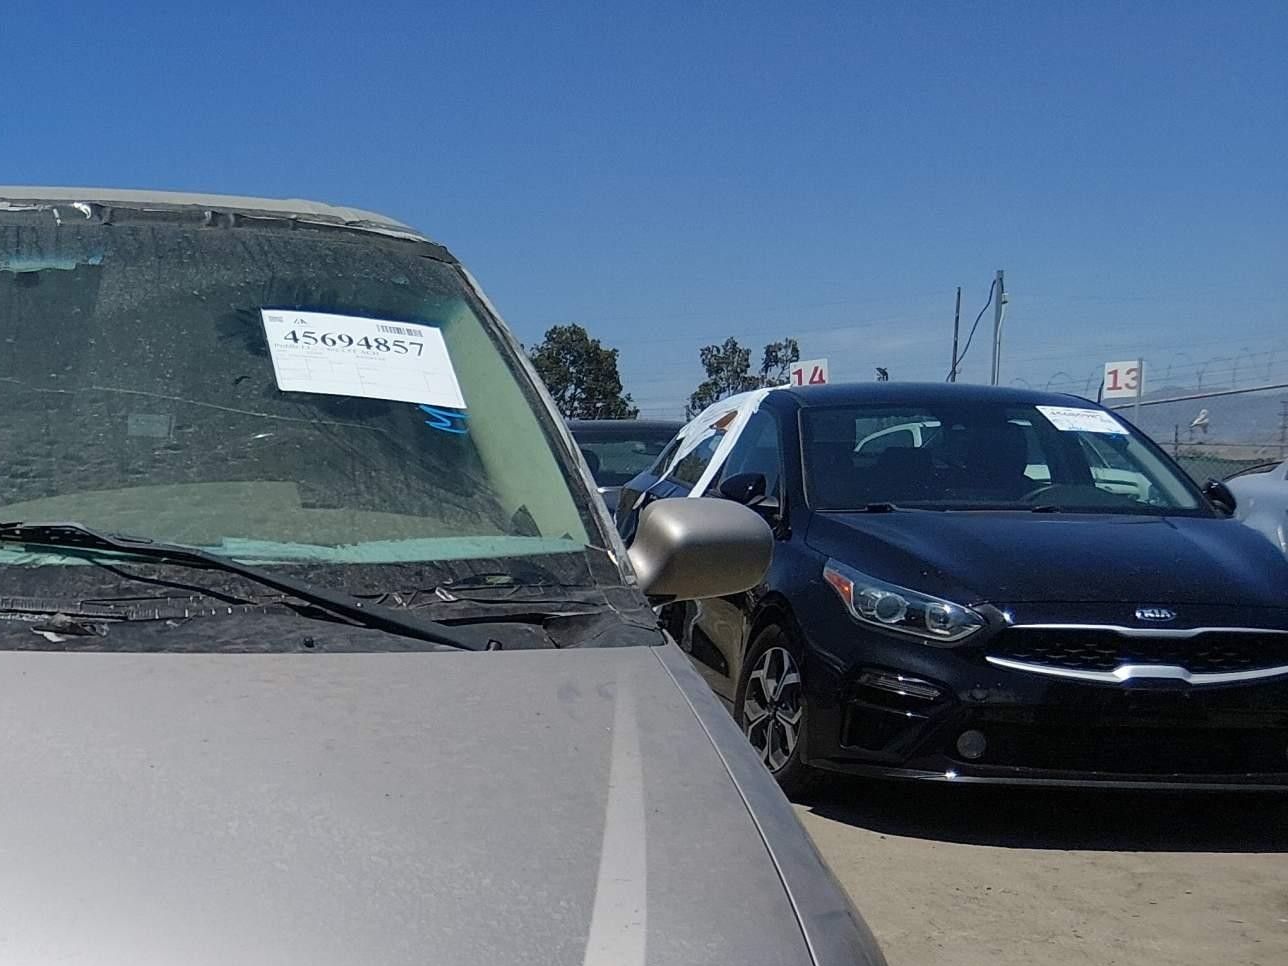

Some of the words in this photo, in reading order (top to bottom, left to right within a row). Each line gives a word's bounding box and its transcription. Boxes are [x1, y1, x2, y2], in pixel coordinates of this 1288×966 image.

[283, 329, 424, 357] 45694857
[792, 365, 826, 386] 14
[1106, 367, 1139, 391] 13
